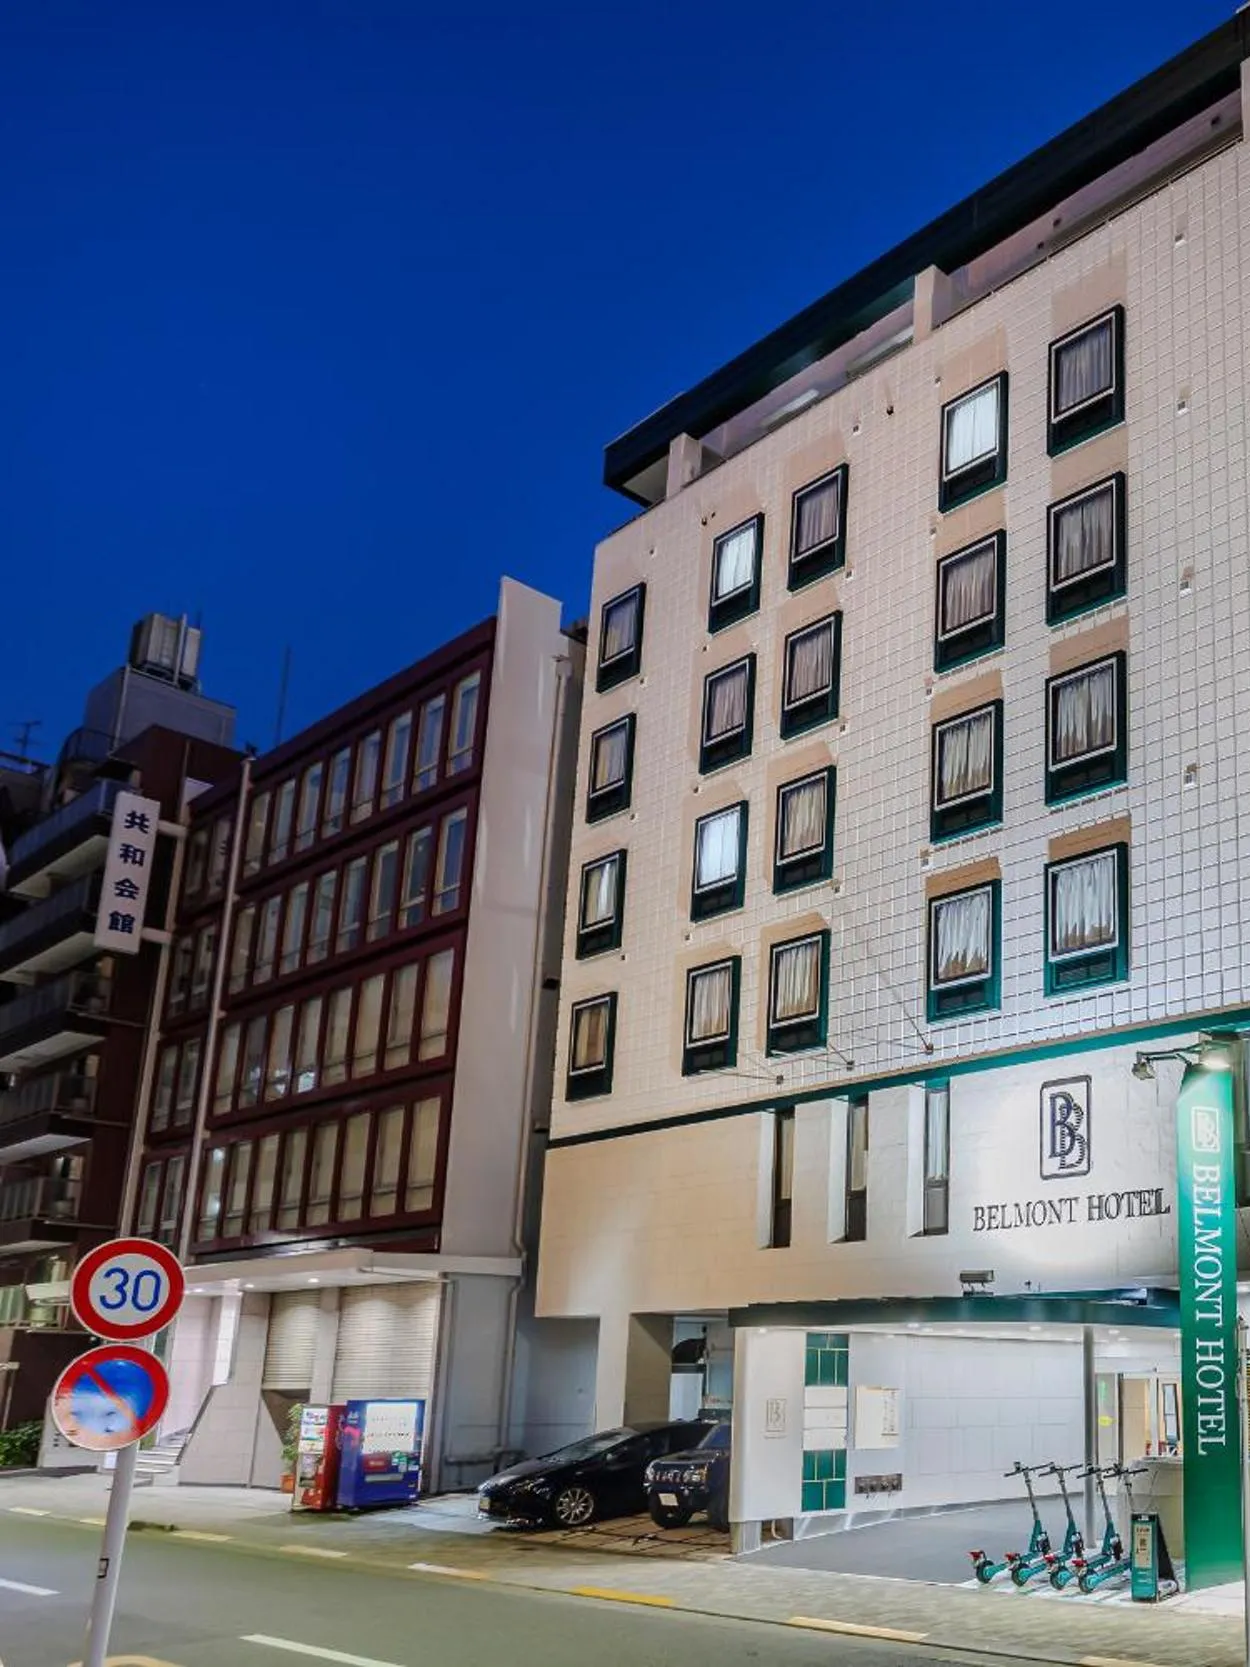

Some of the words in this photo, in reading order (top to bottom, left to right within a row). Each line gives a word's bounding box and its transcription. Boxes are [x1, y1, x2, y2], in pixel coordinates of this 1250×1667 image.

[108, 810, 150, 934] 共和会館
[973, 1196, 1080, 1232] BELMONT
[1087, 1188, 1171, 1221] HOTEL
[1193, 1164, 1223, 1327] BELMONT
[100, 1267, 161, 1312] 30
[1196, 1338, 1226, 1456] HOTEL
